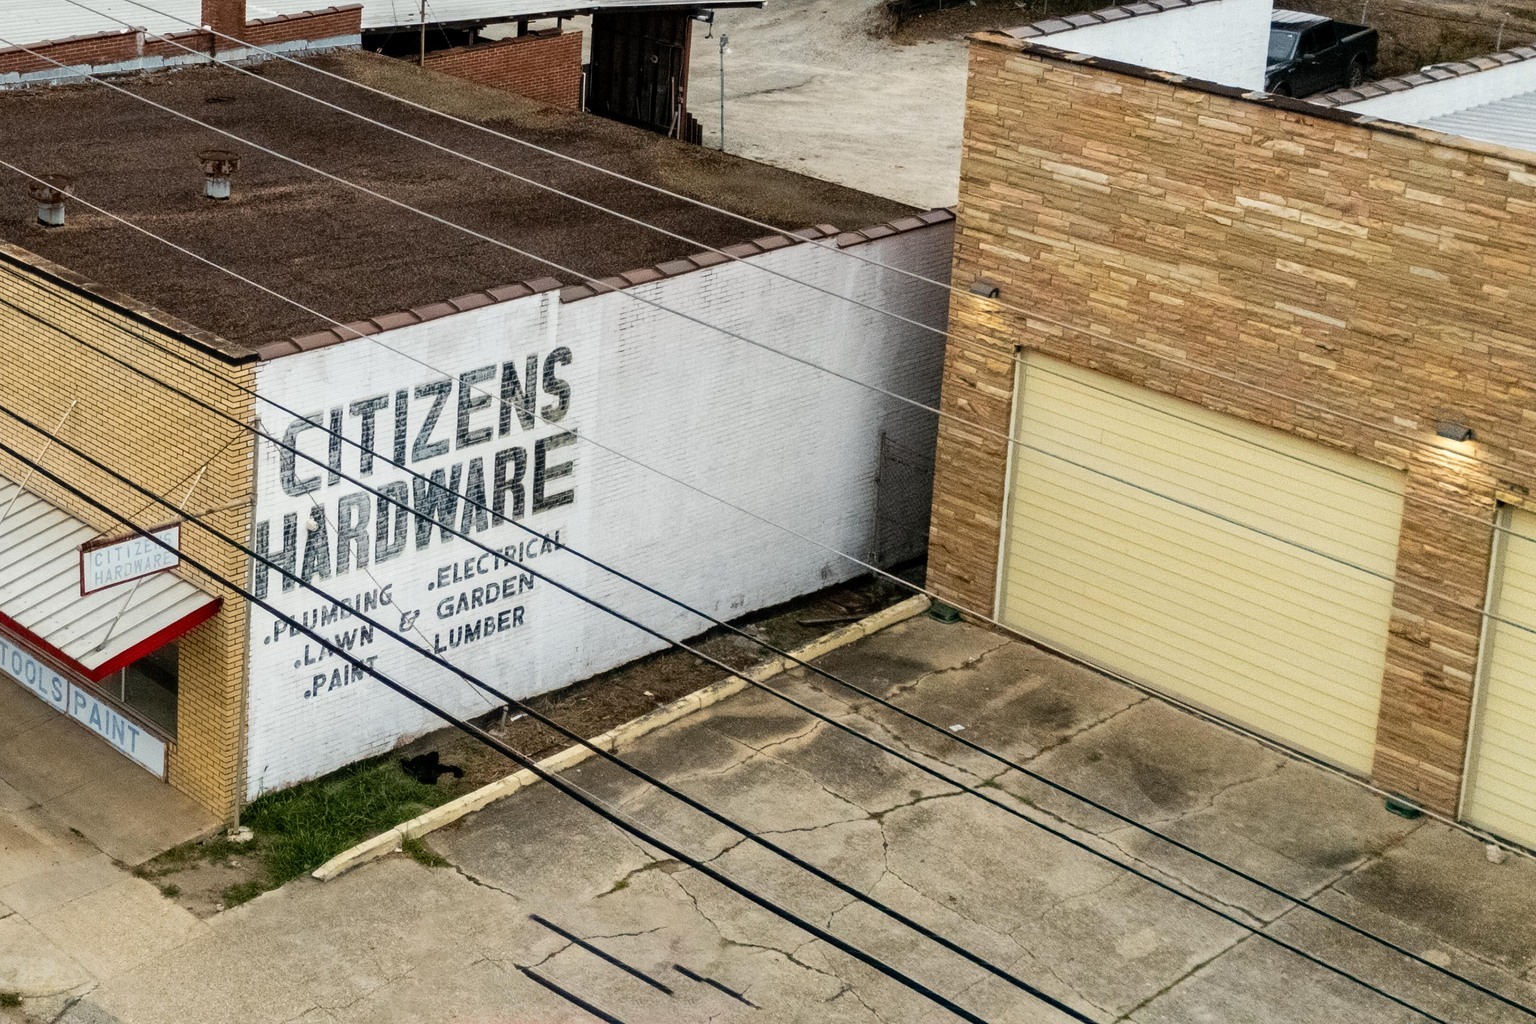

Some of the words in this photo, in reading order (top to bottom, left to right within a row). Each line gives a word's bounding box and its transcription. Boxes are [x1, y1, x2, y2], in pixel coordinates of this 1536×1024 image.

[279, 346, 573, 497] CITIZENS
[254, 427, 578, 601] HARDWARE
[94, 551, 172, 586] HARDWARE
[437, 572, 535, 620] GARDEN
[73, 689, 140, 753] PAINT
